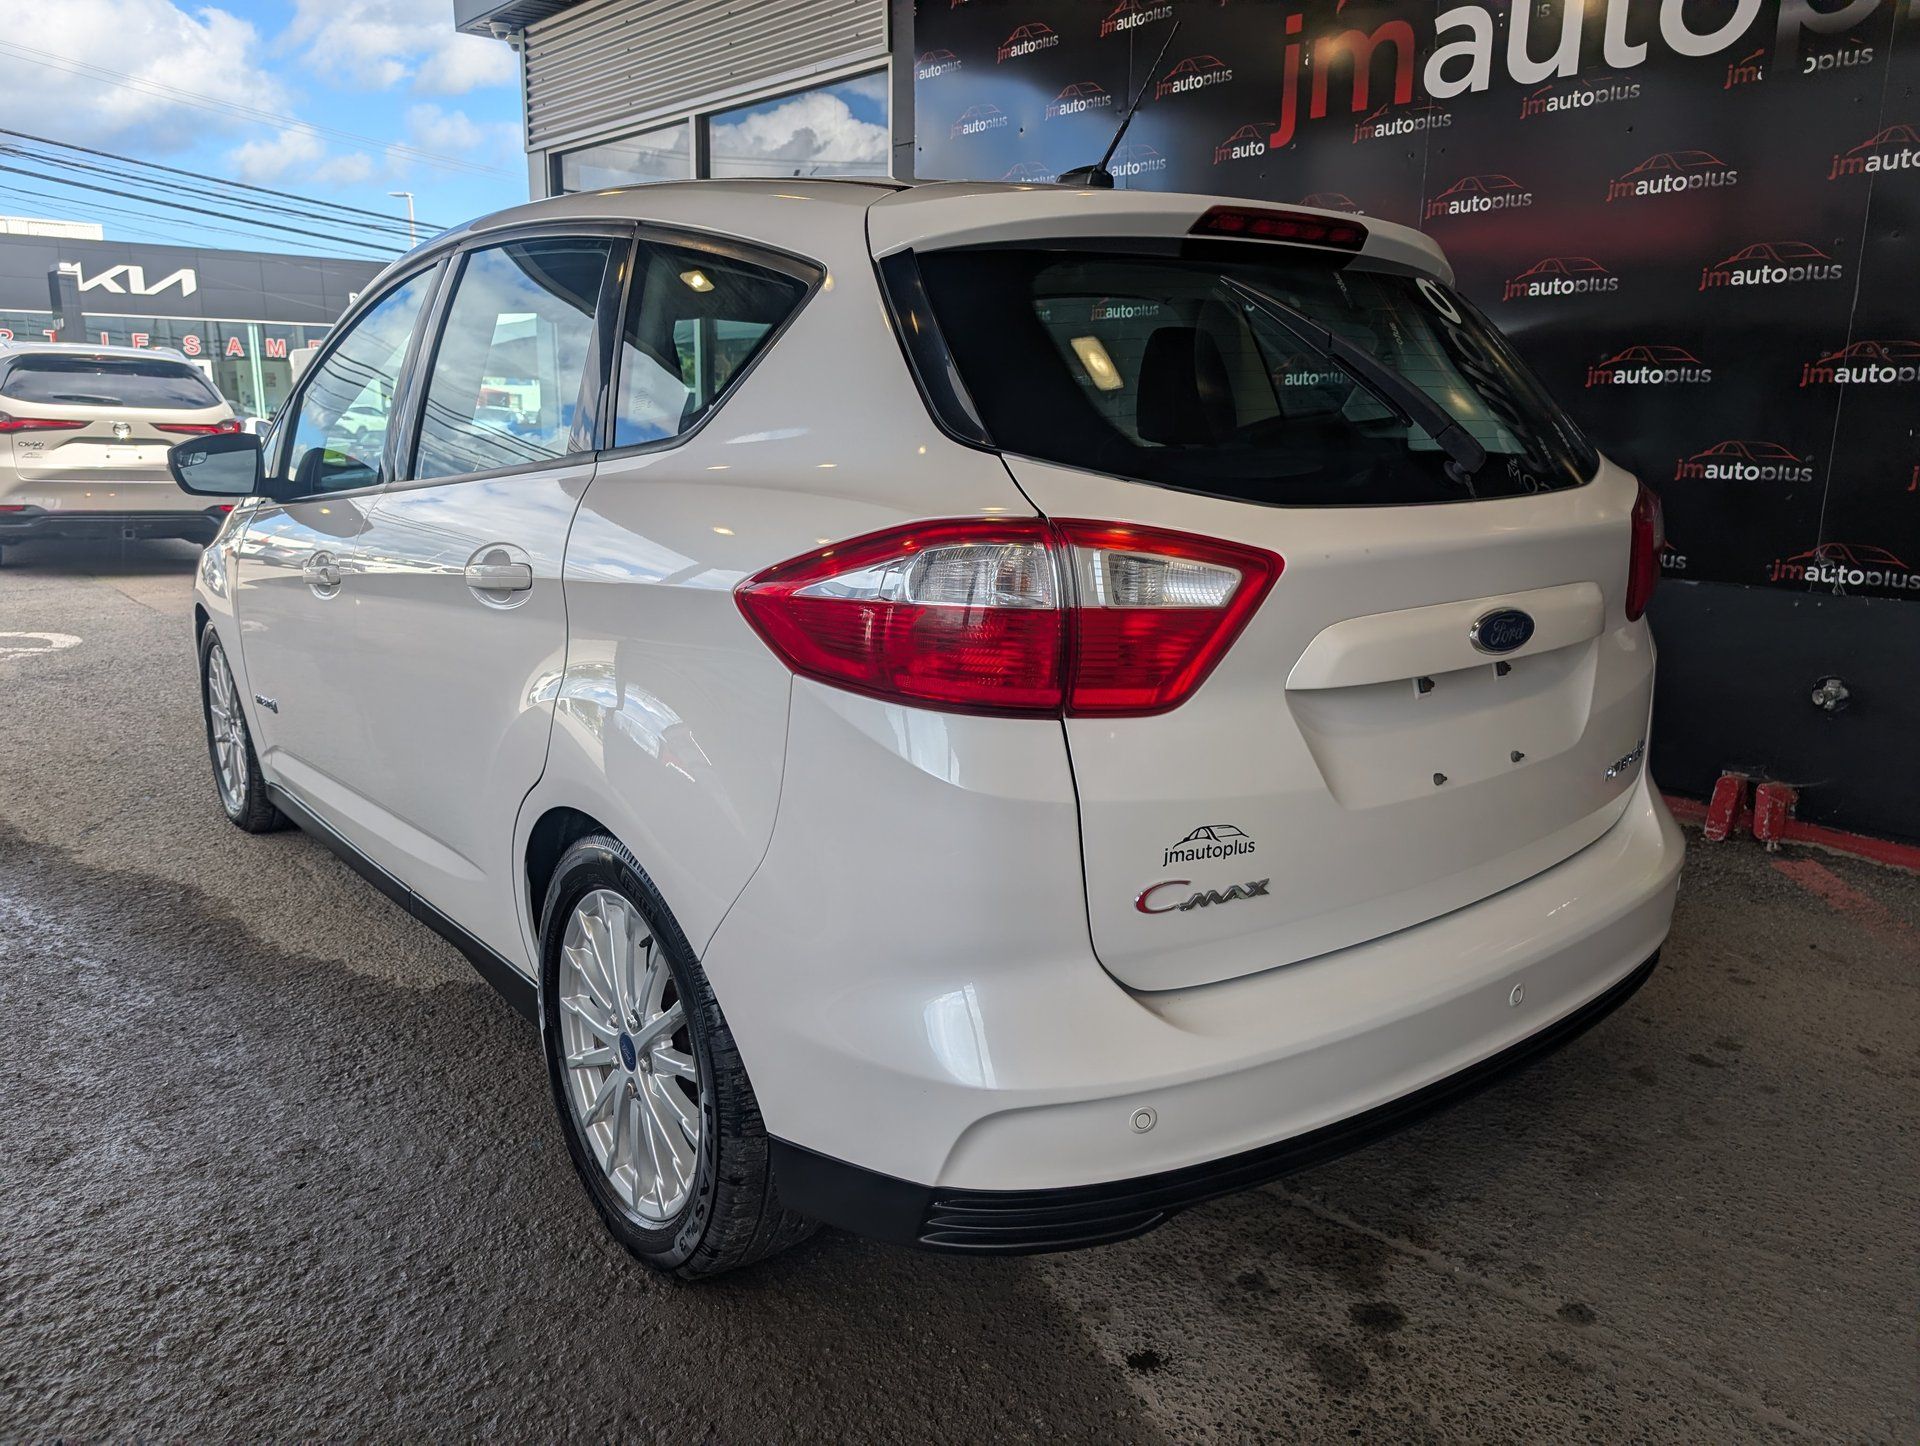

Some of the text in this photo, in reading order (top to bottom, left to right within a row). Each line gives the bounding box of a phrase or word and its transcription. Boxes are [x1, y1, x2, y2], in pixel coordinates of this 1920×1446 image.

[1100, 5, 1174, 38] jmautoplus
[996, 34, 1059, 64] jmautoplus
[914, 59, 962, 82] autoplus
[1154, 68, 1233, 101] jmautoplus
[1045, 94, 1112, 121] jmautoplus
[1520, 83, 1641, 119] jmautoplus
[950, 115, 1008, 139] jmautoplus
[1353, 112, 1453, 145] jmautoplus
[1110, 156, 1167, 178] autoplus
[1212, 141, 1266, 165] jmauto
[1606, 168, 1738, 202] jmautoplus
[1425, 191, 1533, 220] jmautoplus
[58, 261, 197, 298] KIA
[1502, 274, 1619, 302] jmautoplus
[1698, 262, 1843, 291] jmautoplus
[1585, 365, 1712, 389] jmautoplus
[1674, 458, 1813, 483] jmautoplus
[1770, 558, 1920, 590] jmautoplus
[1490, 617, 1526, 646] Ford
[1162, 839, 1256, 867] jmautoplus
